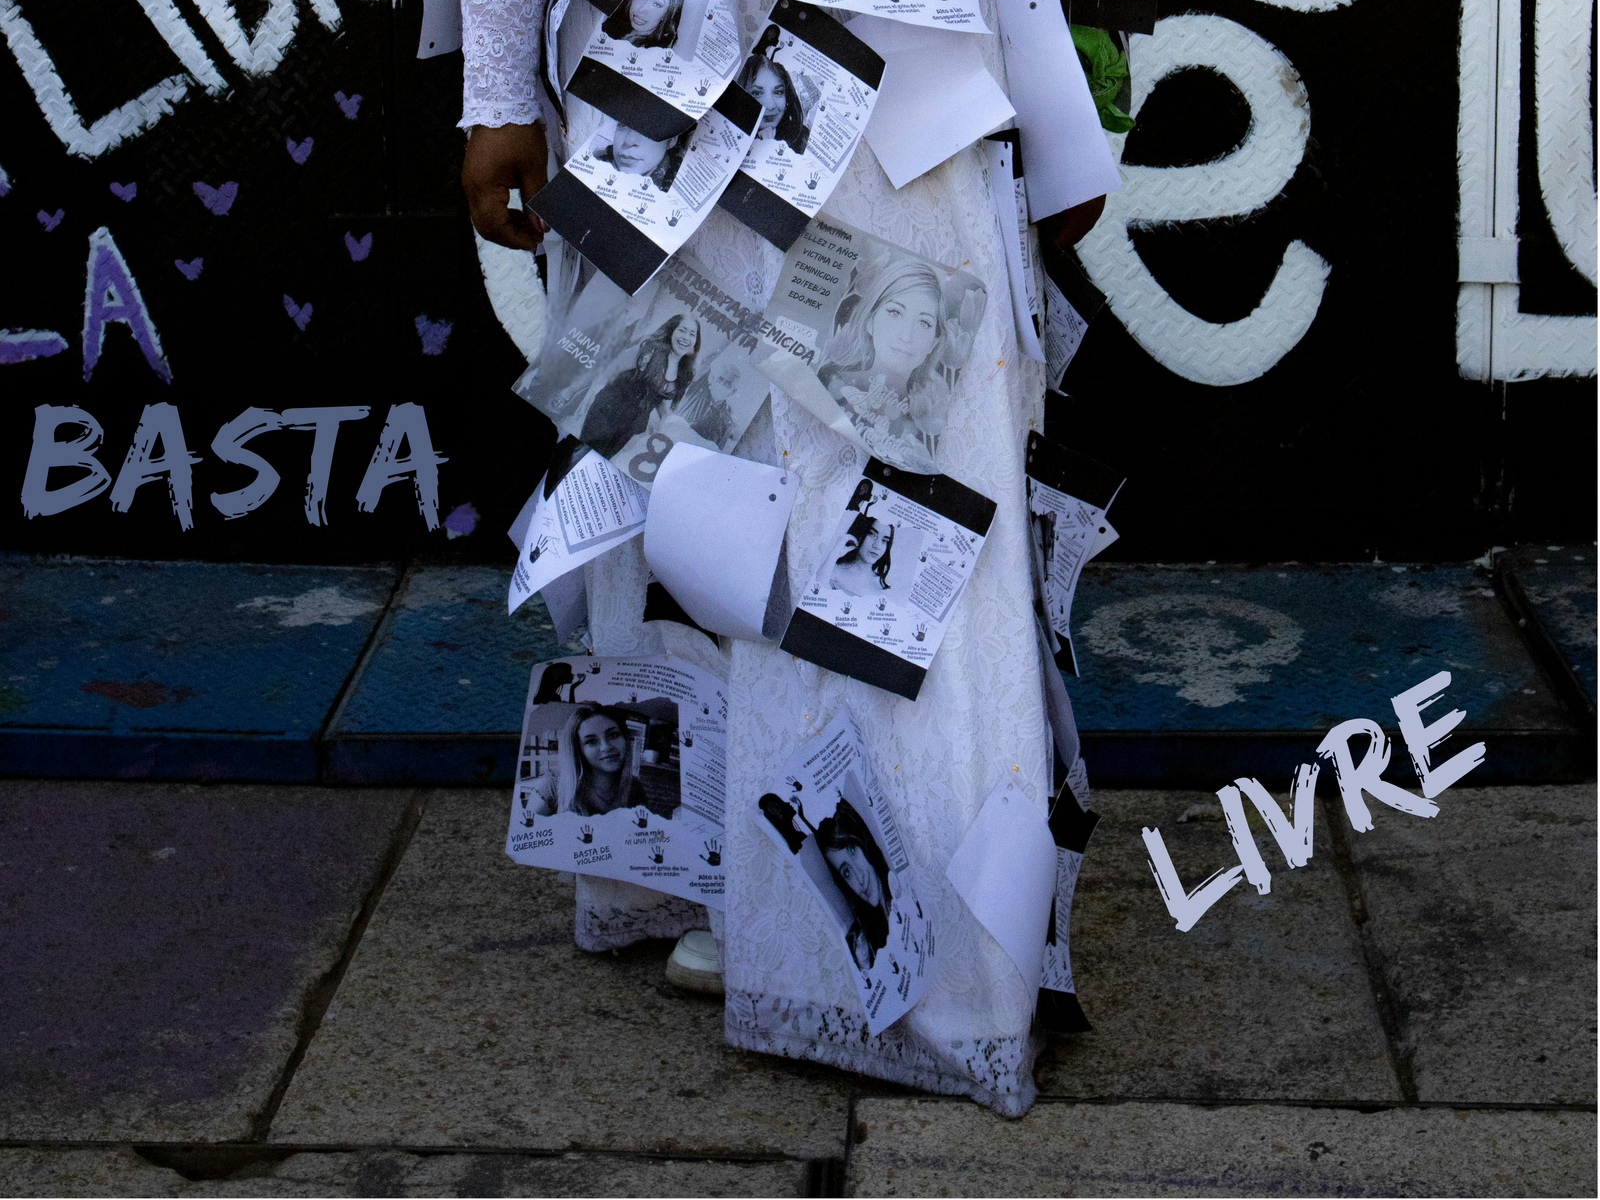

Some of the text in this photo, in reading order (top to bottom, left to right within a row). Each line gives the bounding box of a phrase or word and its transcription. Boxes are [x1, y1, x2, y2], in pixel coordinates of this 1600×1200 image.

[802, 248, 844, 270] VICTIMA DE
[836, 247, 858, 261] AÑOS
[794, 261, 839, 284] FEMINICIDIO
[791, 276, 831, 297] 20/FEB/20
[787, 290, 823, 310] EDO.MEX
[557, 337, 597, 369] MENOS
[510, 828, 553, 843] VIVAS NOS
[513, 838, 555, 852] QUEREMOS
[573, 845, 611, 859] BASTA DE
[577, 853, 613, 866] VIOLENCIA
